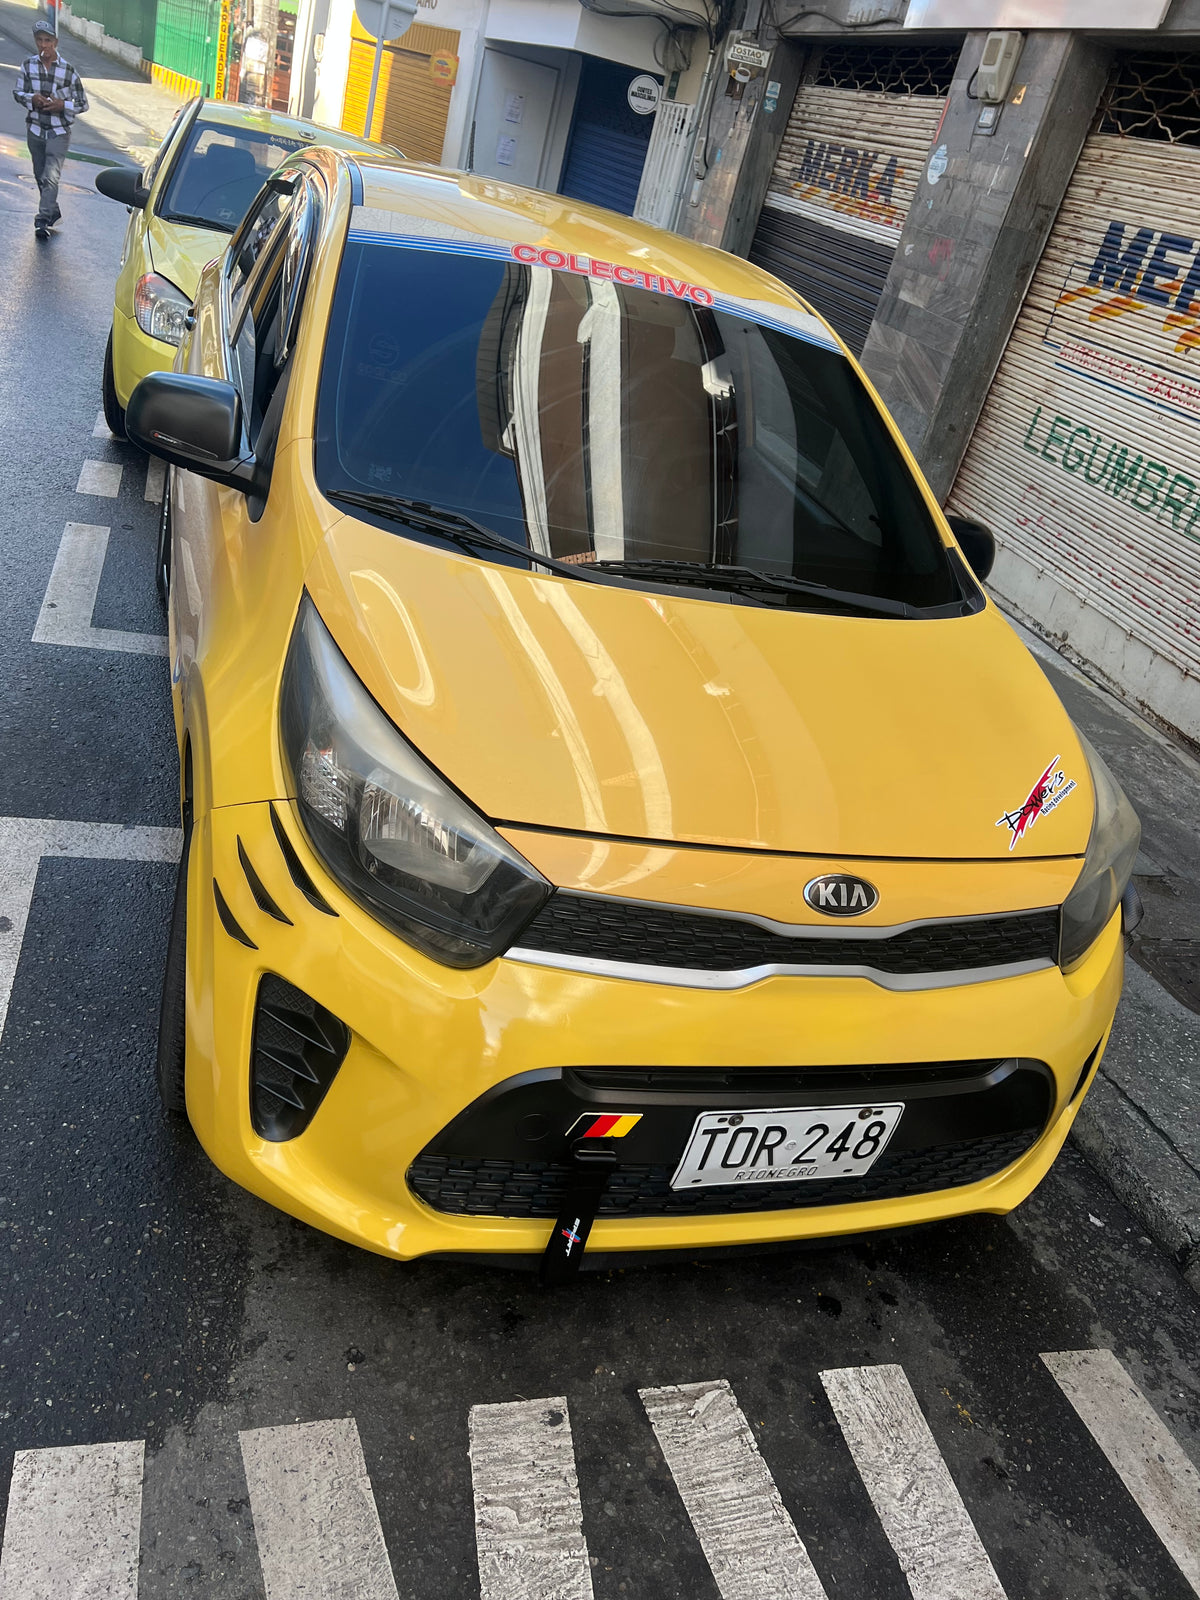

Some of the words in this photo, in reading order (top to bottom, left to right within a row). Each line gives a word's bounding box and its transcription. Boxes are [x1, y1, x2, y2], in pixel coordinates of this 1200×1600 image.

[216, 0, 229, 99] ARQUEADERO
[511, 243, 715, 307] COLECTIVO
[1052, 781, 1077, 806] development
[818, 882, 868, 907] KIA
[697, 1125, 788, 1170] TOR
[792, 1120, 887, 1165] 248
[734, 1165, 818, 1181] RIONEGRO
